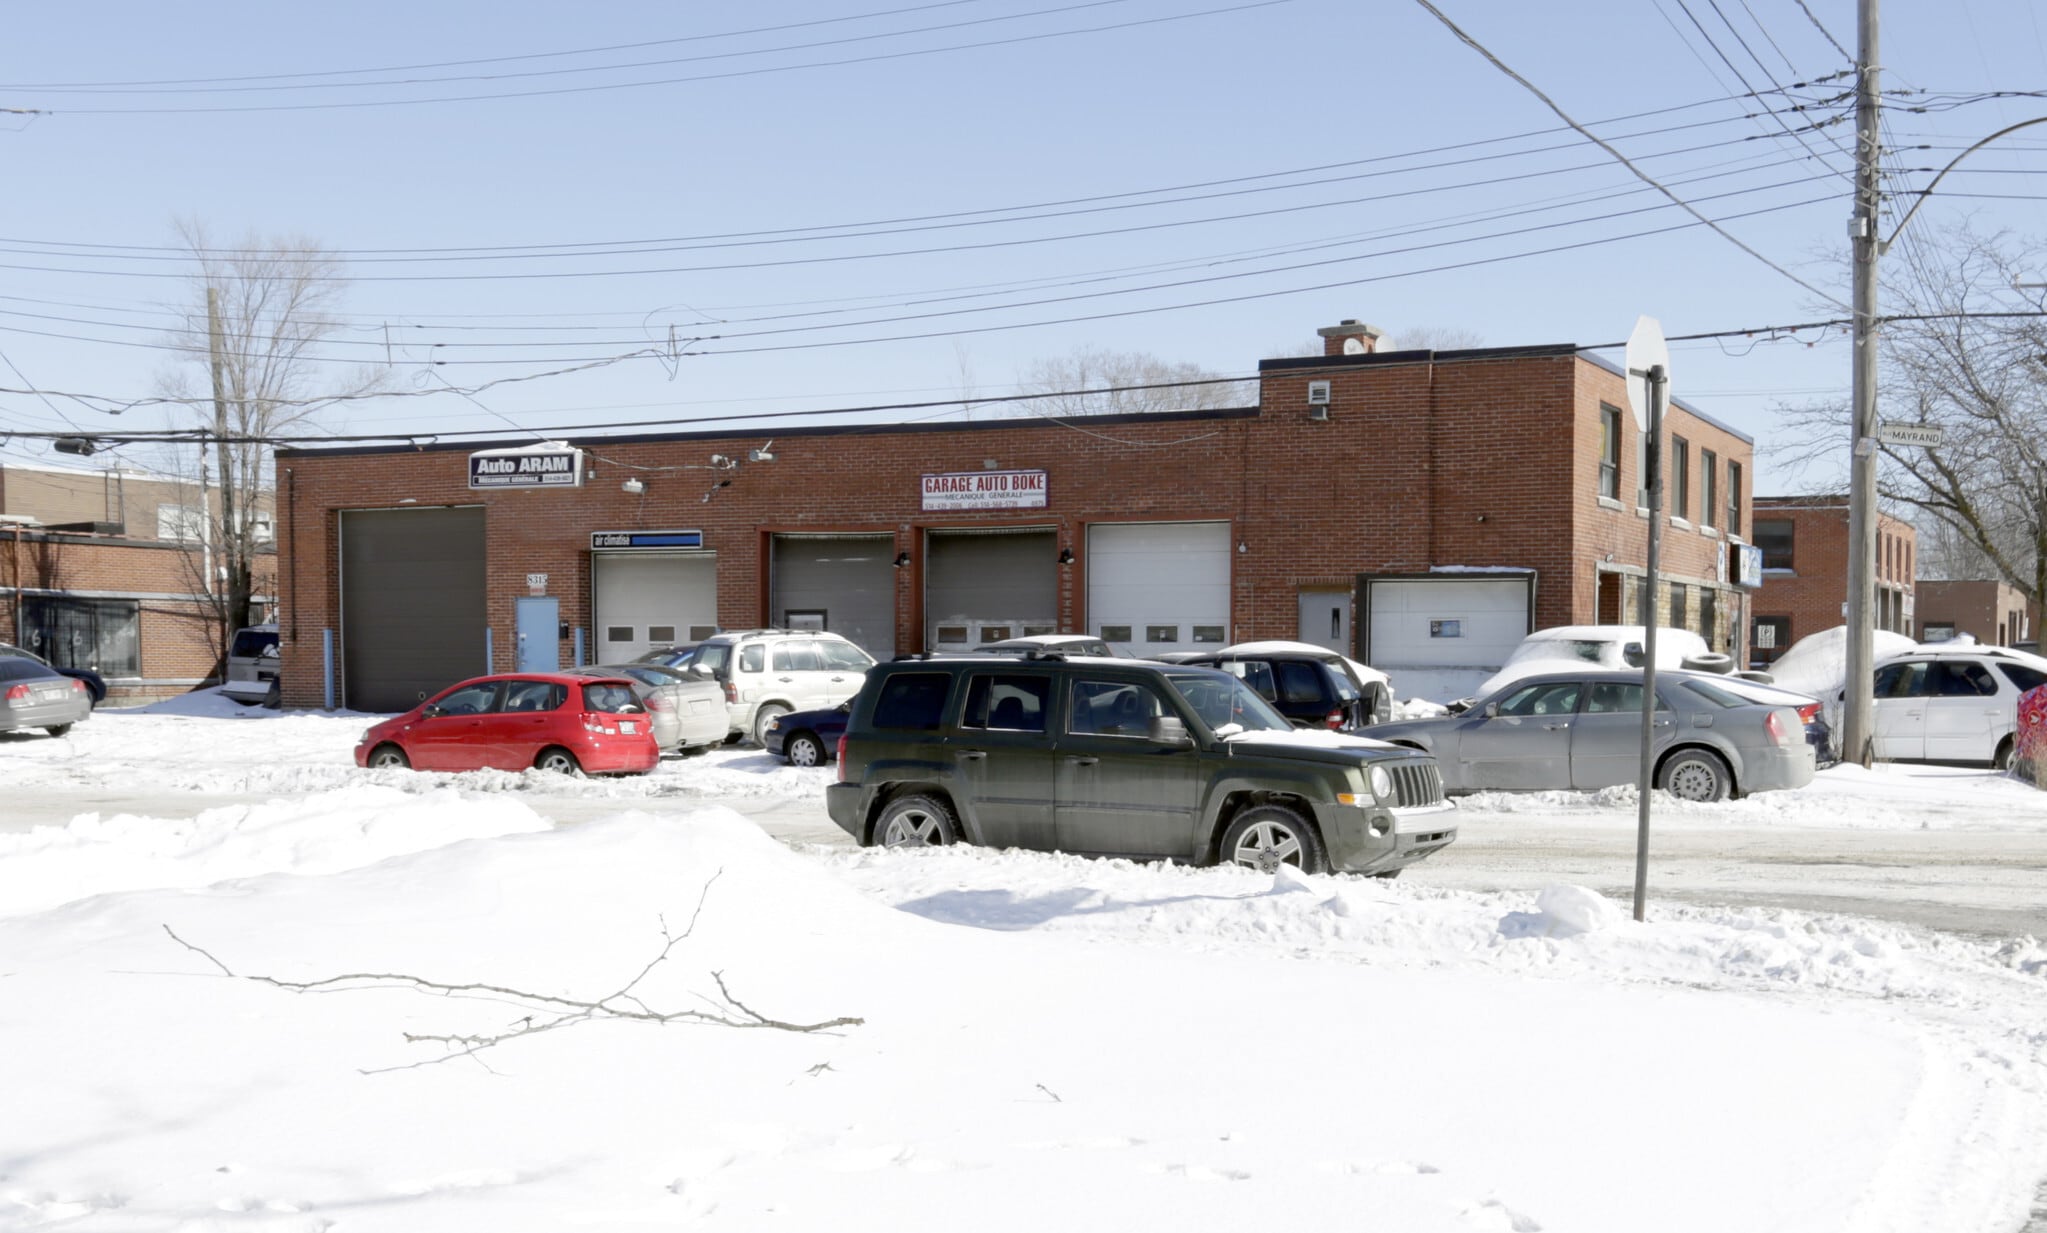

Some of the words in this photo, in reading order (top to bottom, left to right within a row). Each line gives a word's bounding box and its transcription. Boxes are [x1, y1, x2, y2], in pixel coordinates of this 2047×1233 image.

[1892, 431, 1940, 443] MAYRAND
[477, 459, 515, 473] Auto
[519, 456, 569, 472] ARAM
[925, 477, 973, 493] GARAGE
[976, 476, 1008, 491] AUTO
[1012, 474, 1044, 490] BOKE
